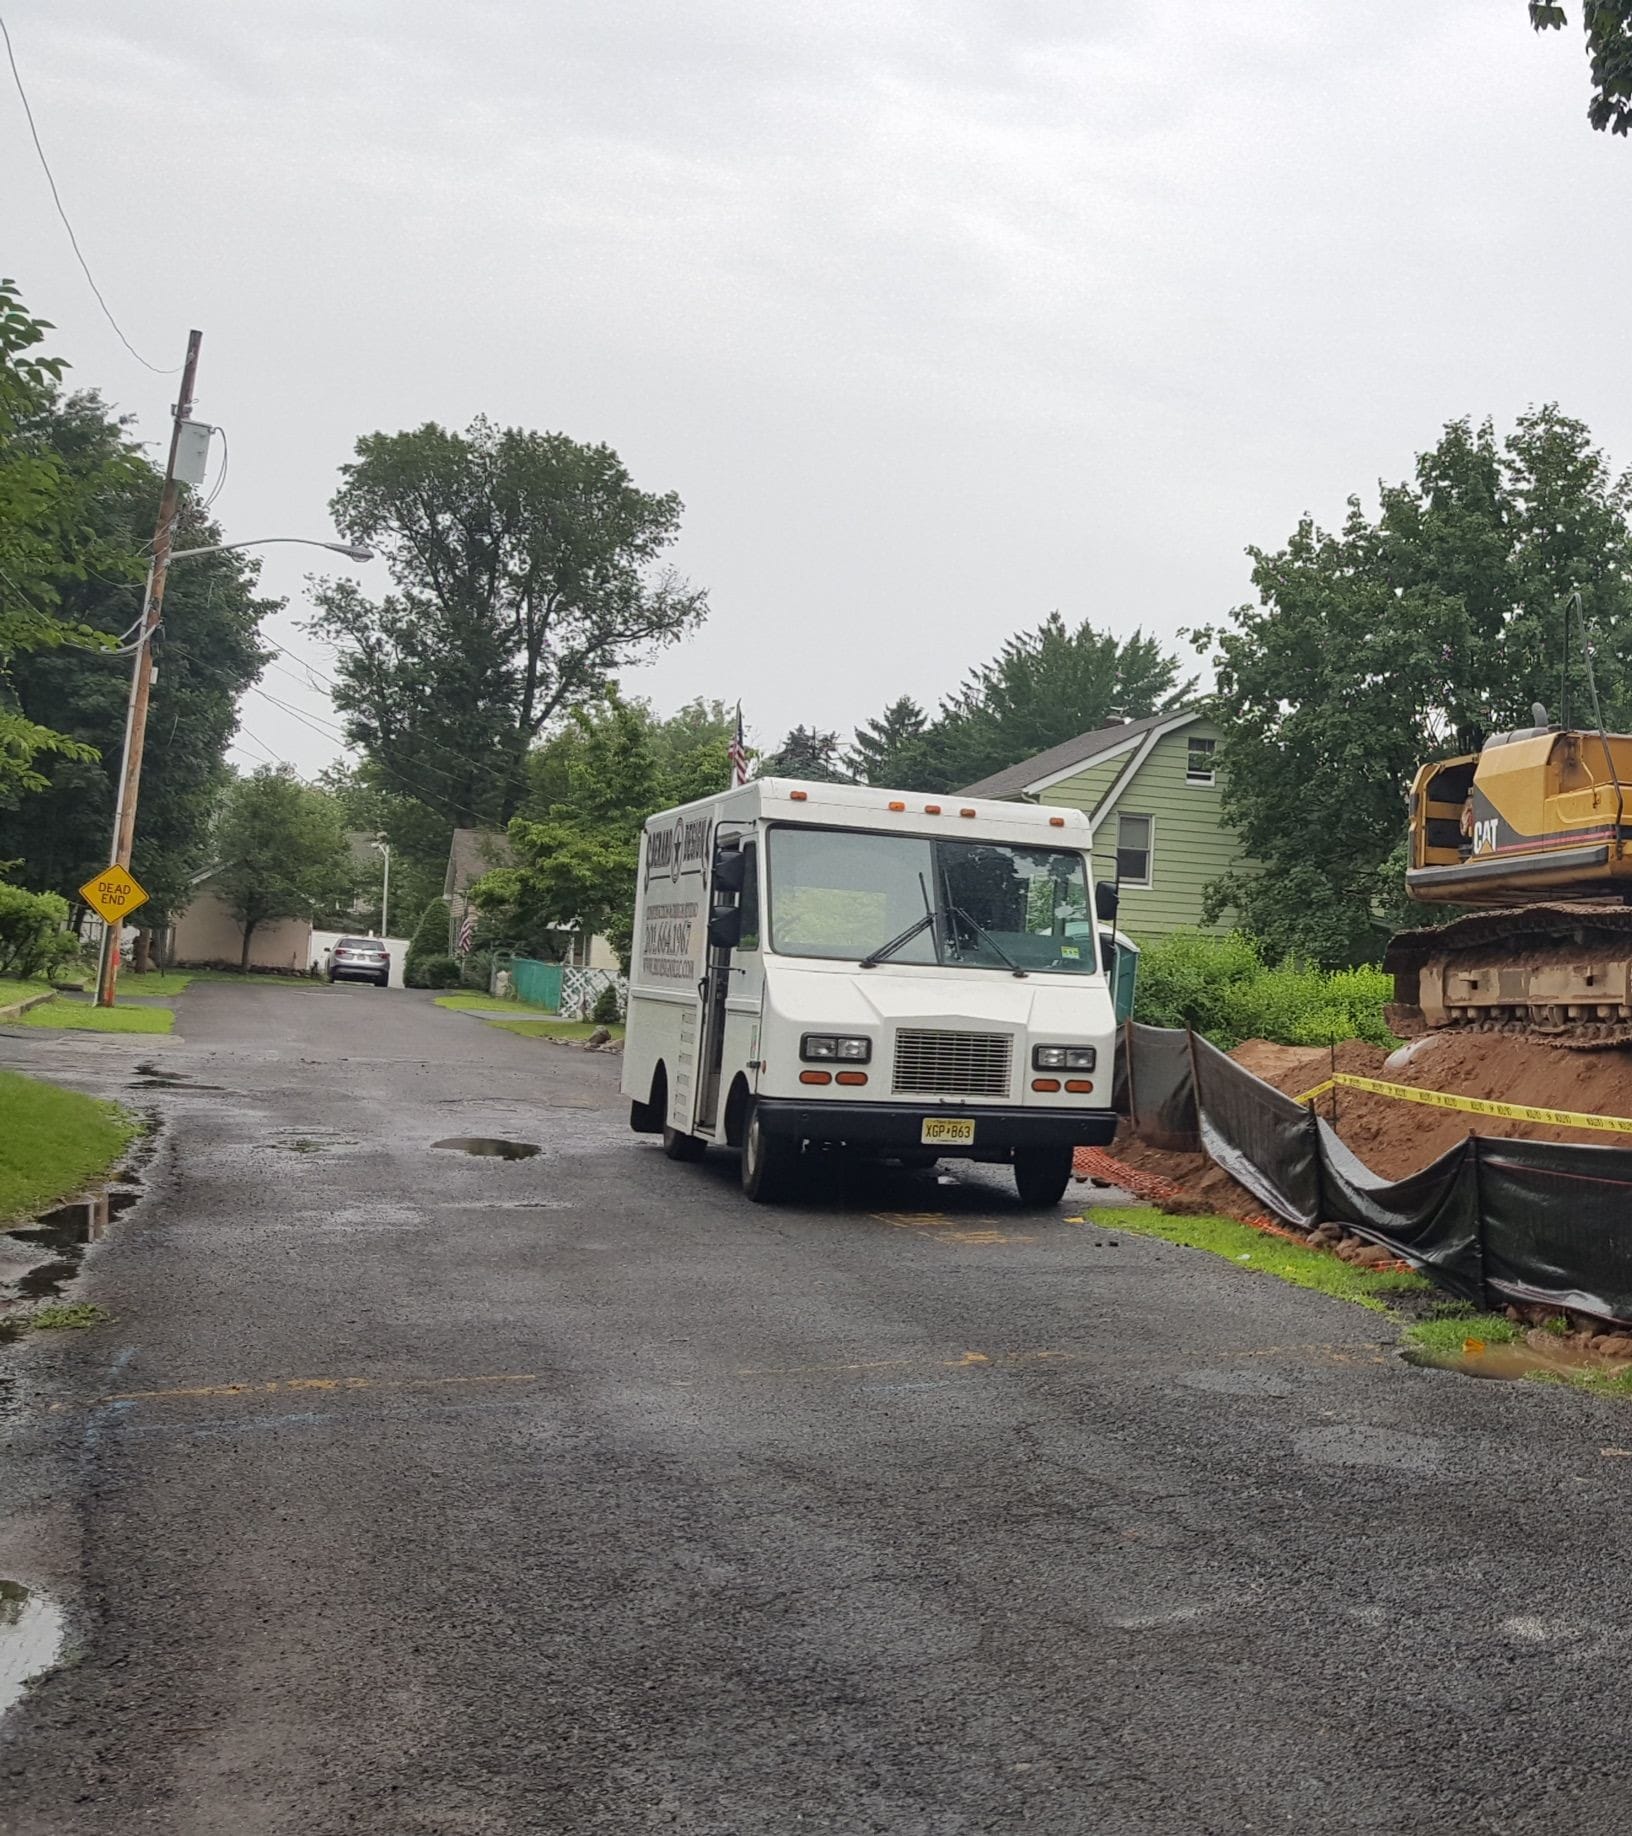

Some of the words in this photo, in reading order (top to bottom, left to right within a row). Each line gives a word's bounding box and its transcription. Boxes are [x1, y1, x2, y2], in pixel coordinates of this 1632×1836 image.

[1473, 818, 1499, 855] CAT
[98, 882, 131, 895] DEAD
[101, 893, 125, 905] END
